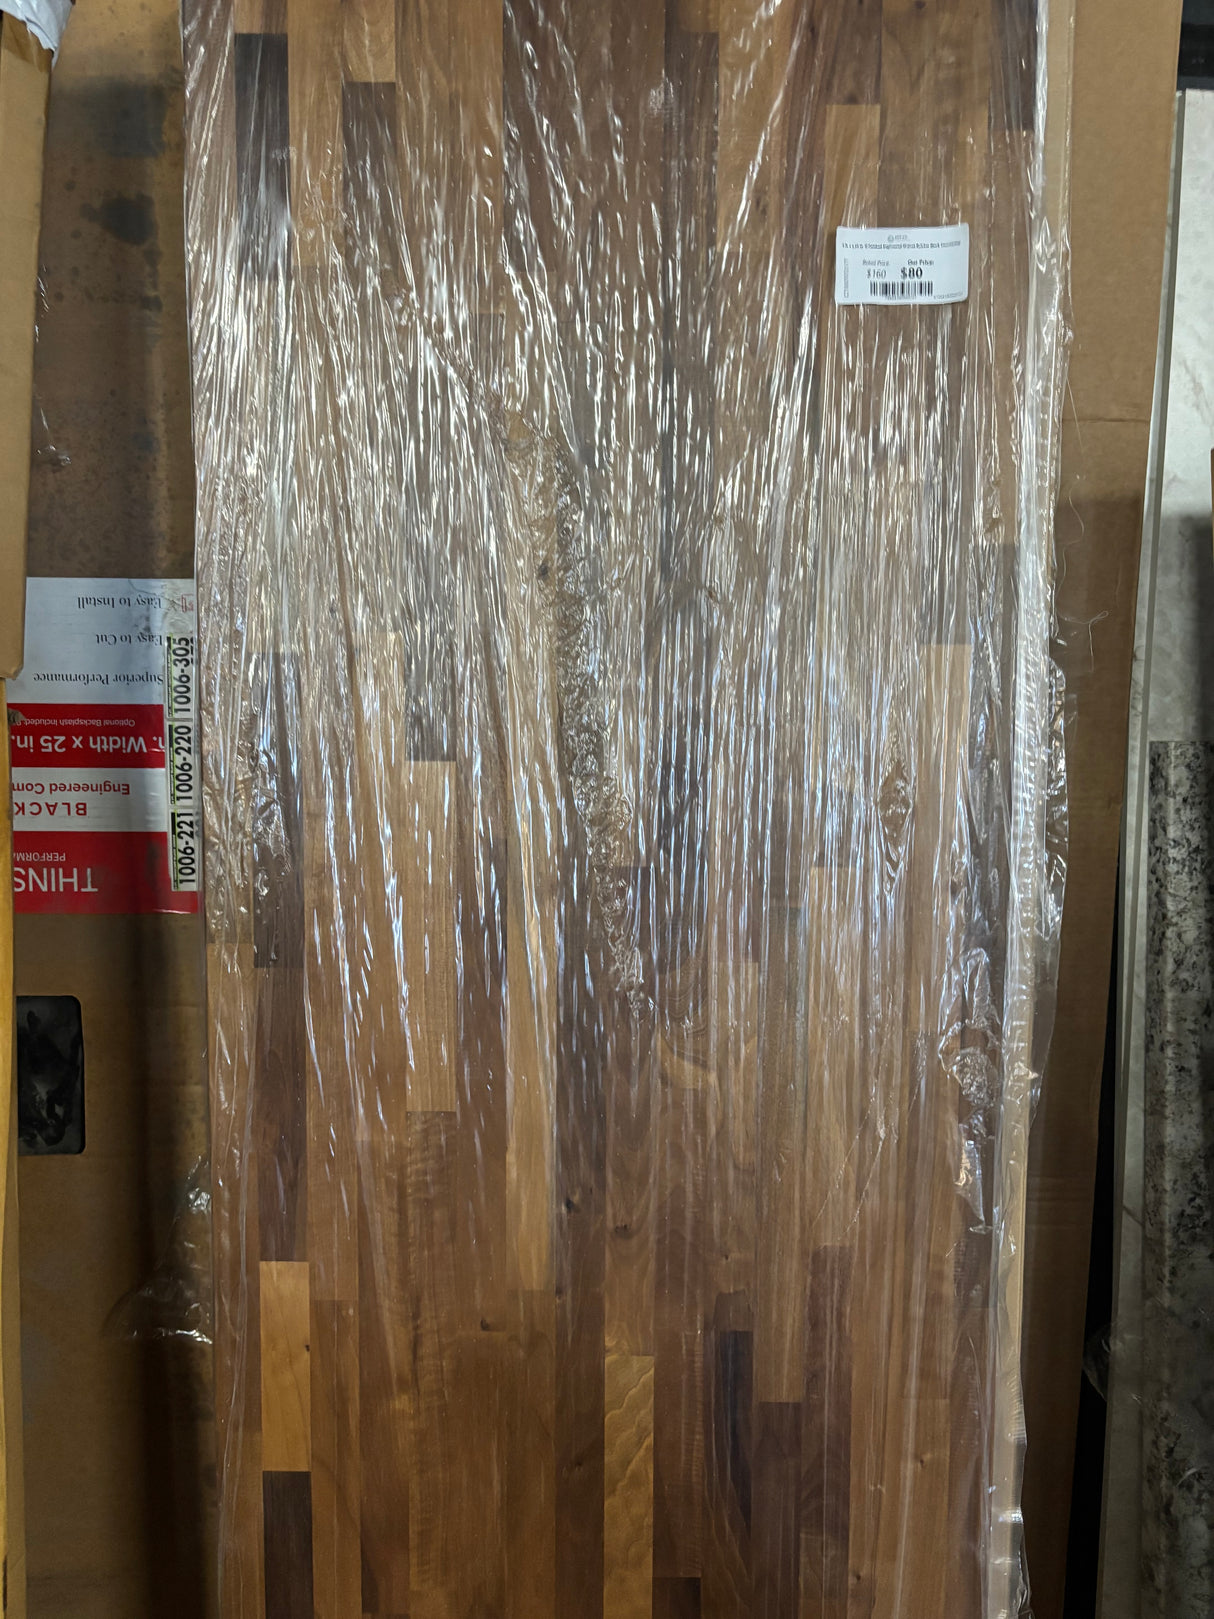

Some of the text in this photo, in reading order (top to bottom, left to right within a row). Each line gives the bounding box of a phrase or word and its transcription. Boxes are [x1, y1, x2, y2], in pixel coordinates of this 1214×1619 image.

[866, 268, 887, 279] $160
[900, 266, 923, 280] $80
[78, 595, 162, 609] Easy to Install
[96, 632, 163, 645] Easy to Cut
[33, 672, 164, 685] Superior Performance
[172, 637, 191, 714] 1006-305
[60, 718, 102, 727] Backsplash
[103, 719, 135, 727] Optional
[11, 736, 34, 752] in.
[40, 736, 66, 753] 25
[72, 736, 83, 748] x
[89, 735, 148, 753] Width
[174, 725, 193, 801] 1006-220
[49, 780, 131, 795] Engineered
[14, 802, 87, 816] BLACK
[176, 811, 196, 885] 1006-221
[14, 867, 98, 892] THINS
